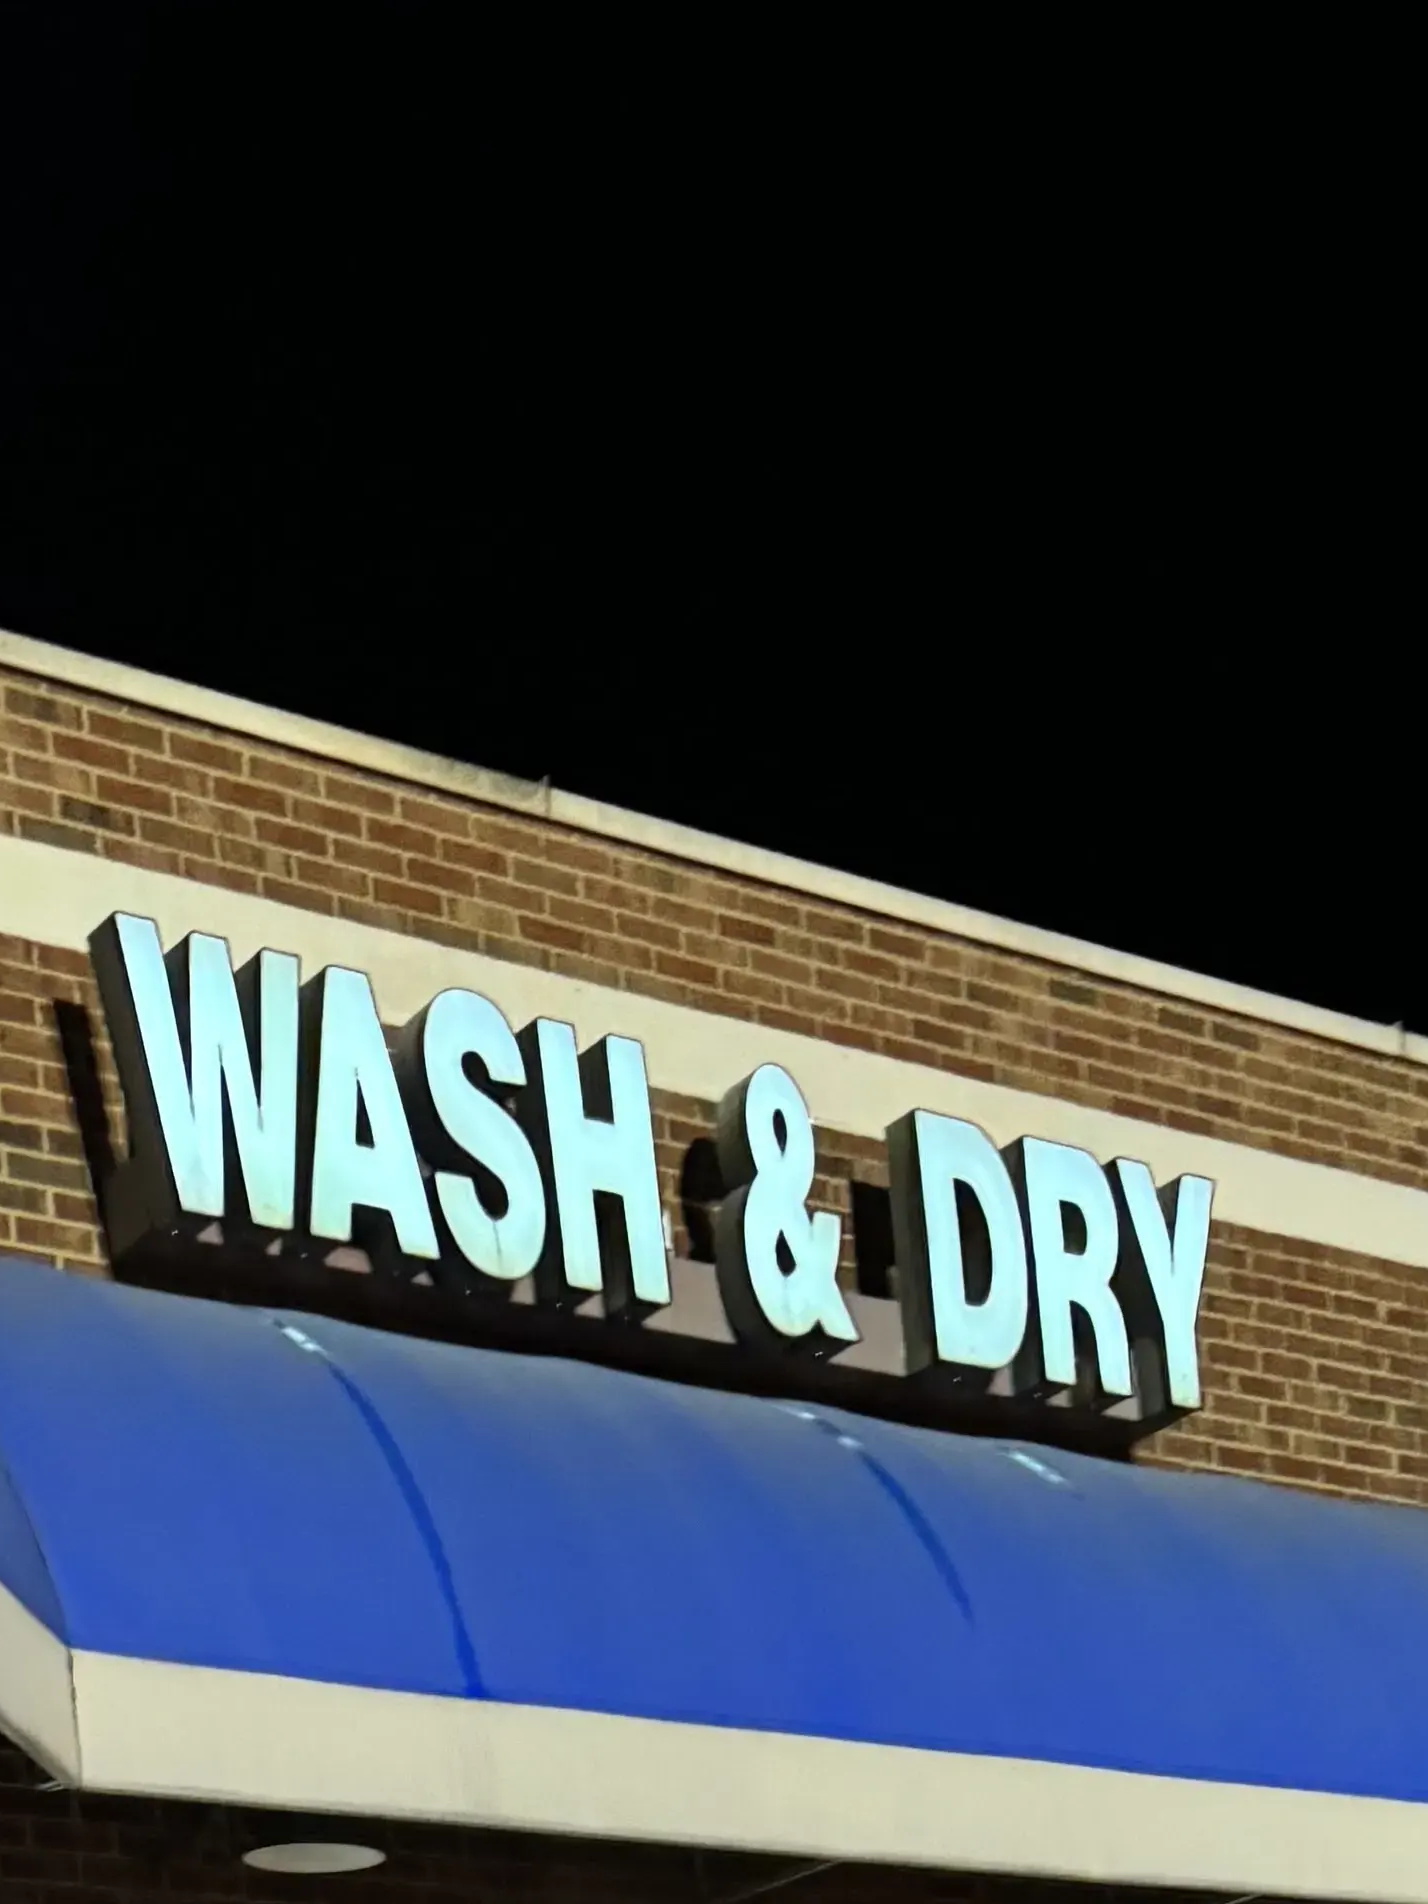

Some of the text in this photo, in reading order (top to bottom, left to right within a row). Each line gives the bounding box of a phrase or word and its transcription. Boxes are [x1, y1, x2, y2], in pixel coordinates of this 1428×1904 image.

[112, 910, 1215, 1410] WASH & DRY
